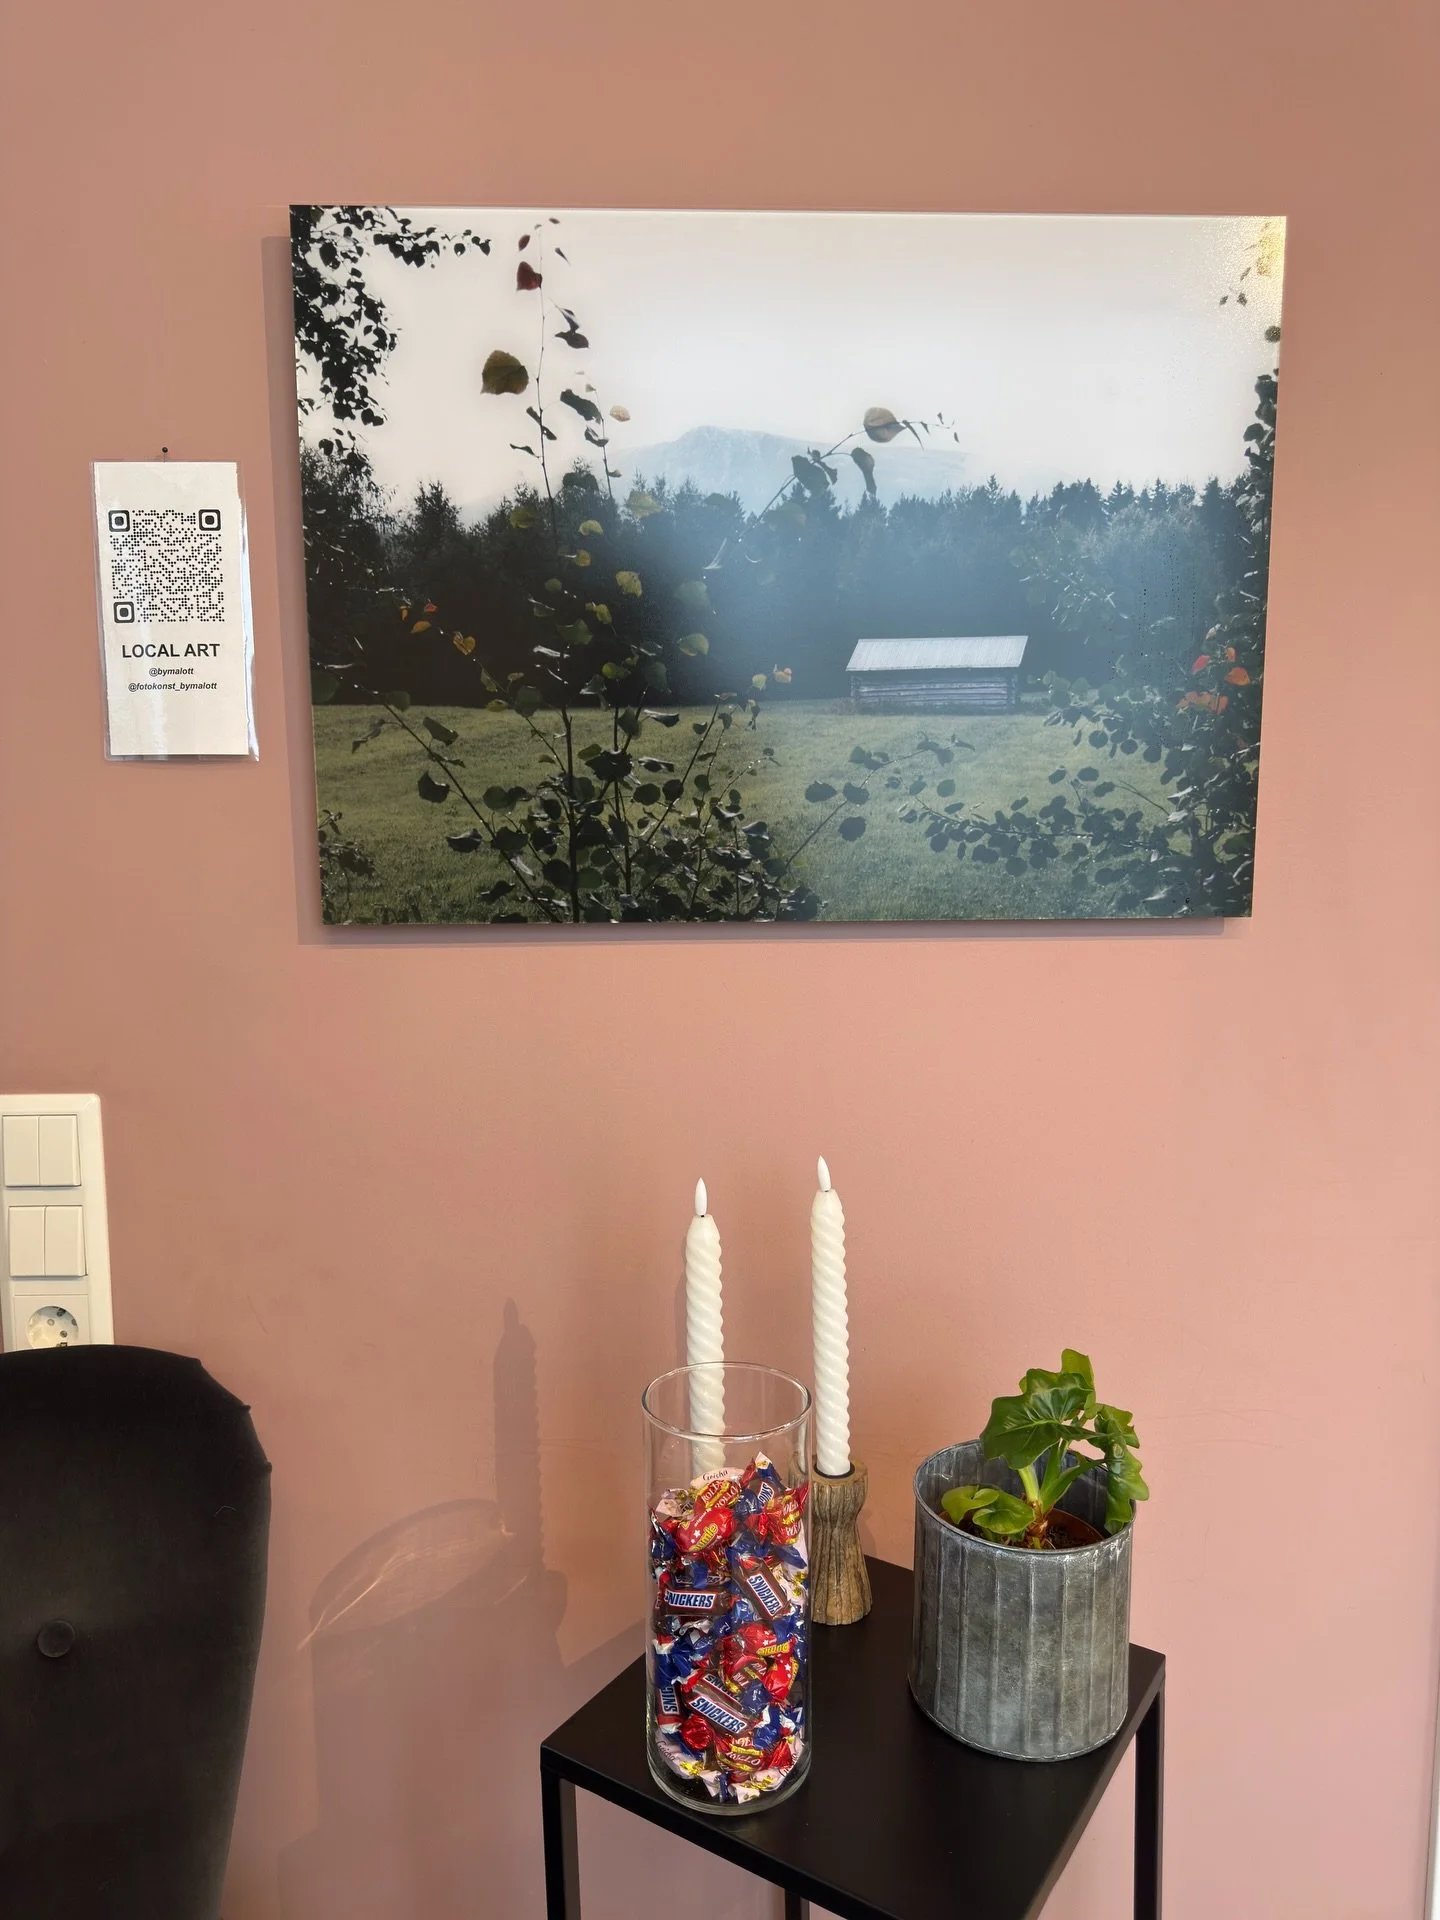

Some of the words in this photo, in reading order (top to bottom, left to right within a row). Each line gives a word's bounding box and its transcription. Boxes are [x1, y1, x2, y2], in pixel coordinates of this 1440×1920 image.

[122, 643, 180, 658] LOCAL
[184, 643, 221, 657] ART
[149, 667, 194, 677] @bymalott
[128, 682, 217, 692] @fotokonst_bymalott
[702, 1469, 728, 1481] Geisha
[749, 1575, 780, 1615] SNICKERS
[692, 1698, 745, 1732] SNICKERS
